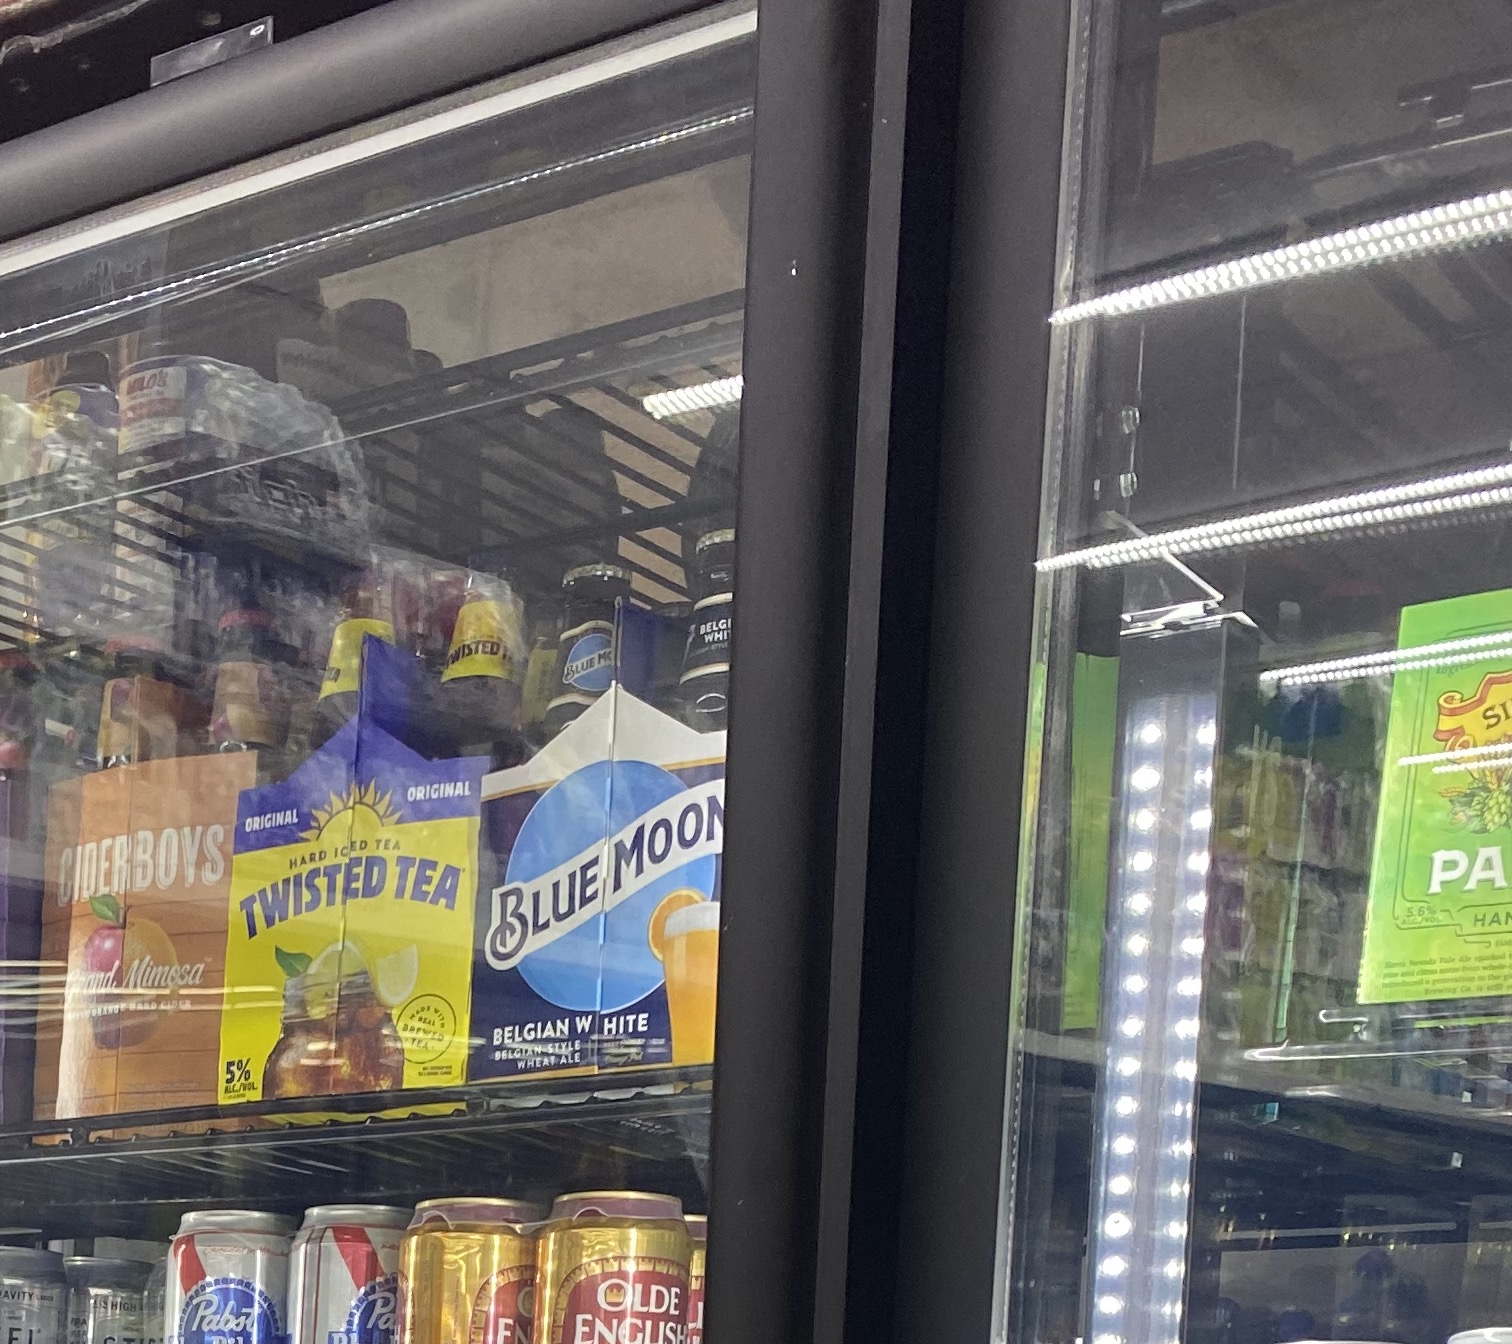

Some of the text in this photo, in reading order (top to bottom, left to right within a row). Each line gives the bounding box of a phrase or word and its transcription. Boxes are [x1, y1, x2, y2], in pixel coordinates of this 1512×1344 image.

[407, 781, 471, 802] ORIGINAL
[245, 808, 298, 832] ORIGINAL
[57, 824, 225, 907] CIDERBOYS
[289, 839, 401, 870] HARD ICED TEA
[240, 855, 460, 940] TWISTED TEA
[488, 856, 602, 962] BLUE
[123, 954, 205, 988] Mimosa
[493, 1013, 649, 1046] BELGIAN WHITE
[225, 1058, 251, 1084] 5%
[517, 1052, 581, 1070] WHEAT ALE
[191, 1292, 263, 1333] Pabst
[597, 1278, 681, 1314] OLDE
